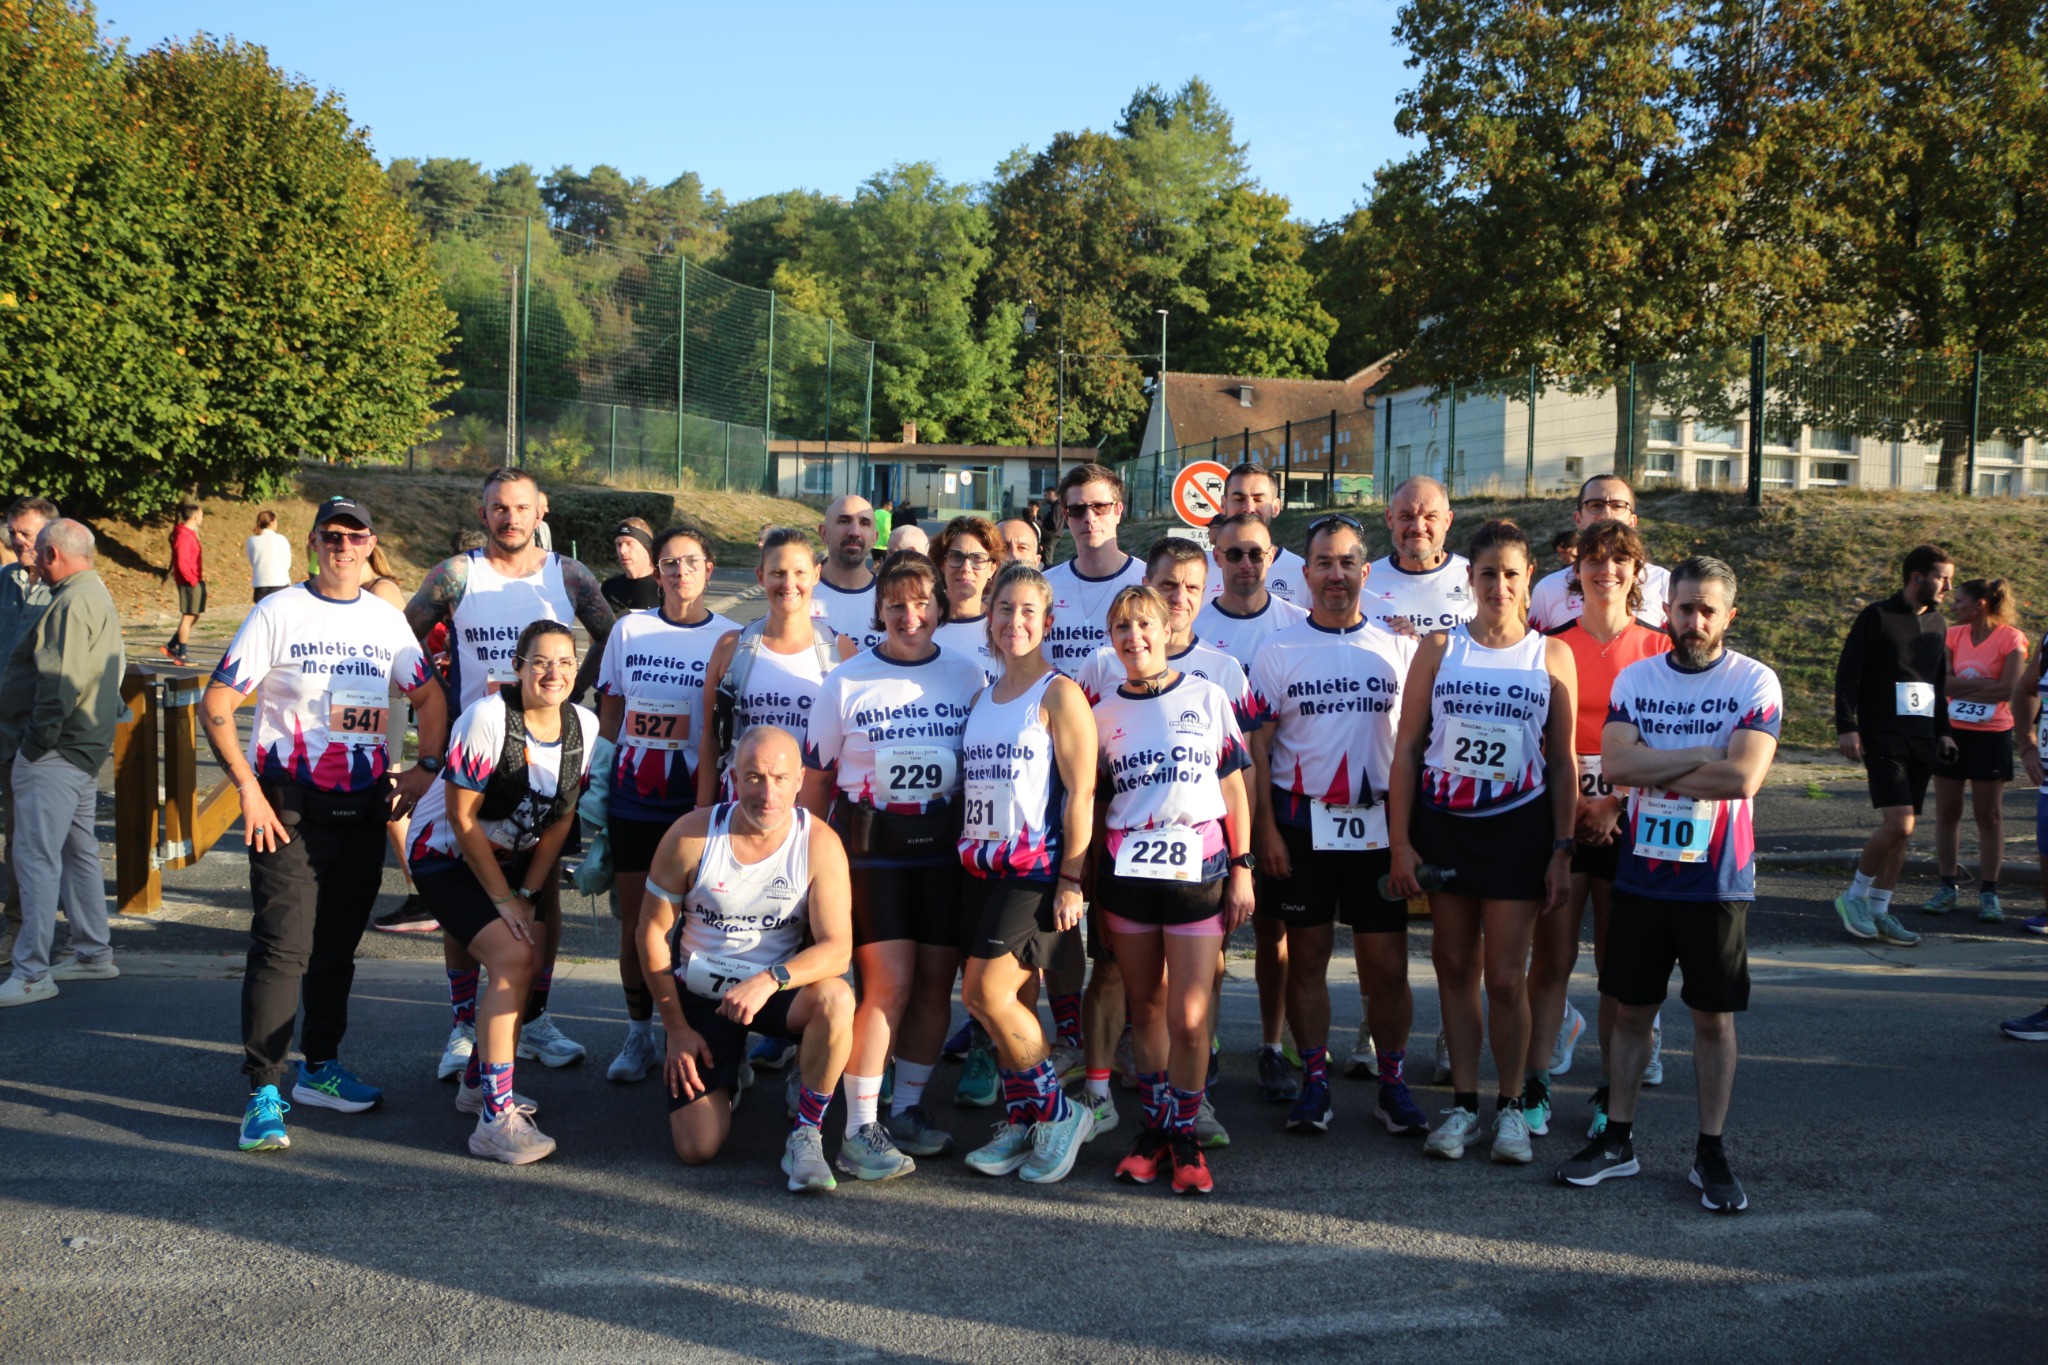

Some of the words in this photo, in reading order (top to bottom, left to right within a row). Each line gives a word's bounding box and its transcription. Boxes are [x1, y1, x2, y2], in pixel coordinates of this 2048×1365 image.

[1191, 531, 1210, 539] SAU
[465, 626, 519, 642] Athléti
[290, 641, 357, 658] Athlétic
[363, 644, 392, 661] Club
[302, 659, 386, 679] Mérévillois
[626, 654, 685, 670] Athlétic
[631, 669, 705, 688] Mérévillo
[1287, 677, 1360, 698] Athlétic
[741, 692, 791, 710] hlétic
[1435, 681, 1501, 699] Athlétic
[1508, 685, 1545, 707] Club
[1911, 692, 1920, 708] 3
[856, 704, 929, 727] Athlétic
[1300, 697, 1393, 716] Mérévillois
[1443, 700, 1533, 721] Mérévillois
[1956, 702, 1987, 717] 233
[342, 707, 380, 732] 541
[634, 714, 677, 738] 527
[996, 743, 1035, 761] Club
[1171, 746, 1211, 767] Club
[1454, 737, 1507, 767] 232
[890, 764, 942, 790] 229
[1579, 773, 1613, 796] 26
[967, 799, 994, 826] 231
[1333, 817, 1366, 839] 70
[1645, 817, 1694, 847] 710
[1131, 840, 1188, 866] 228
